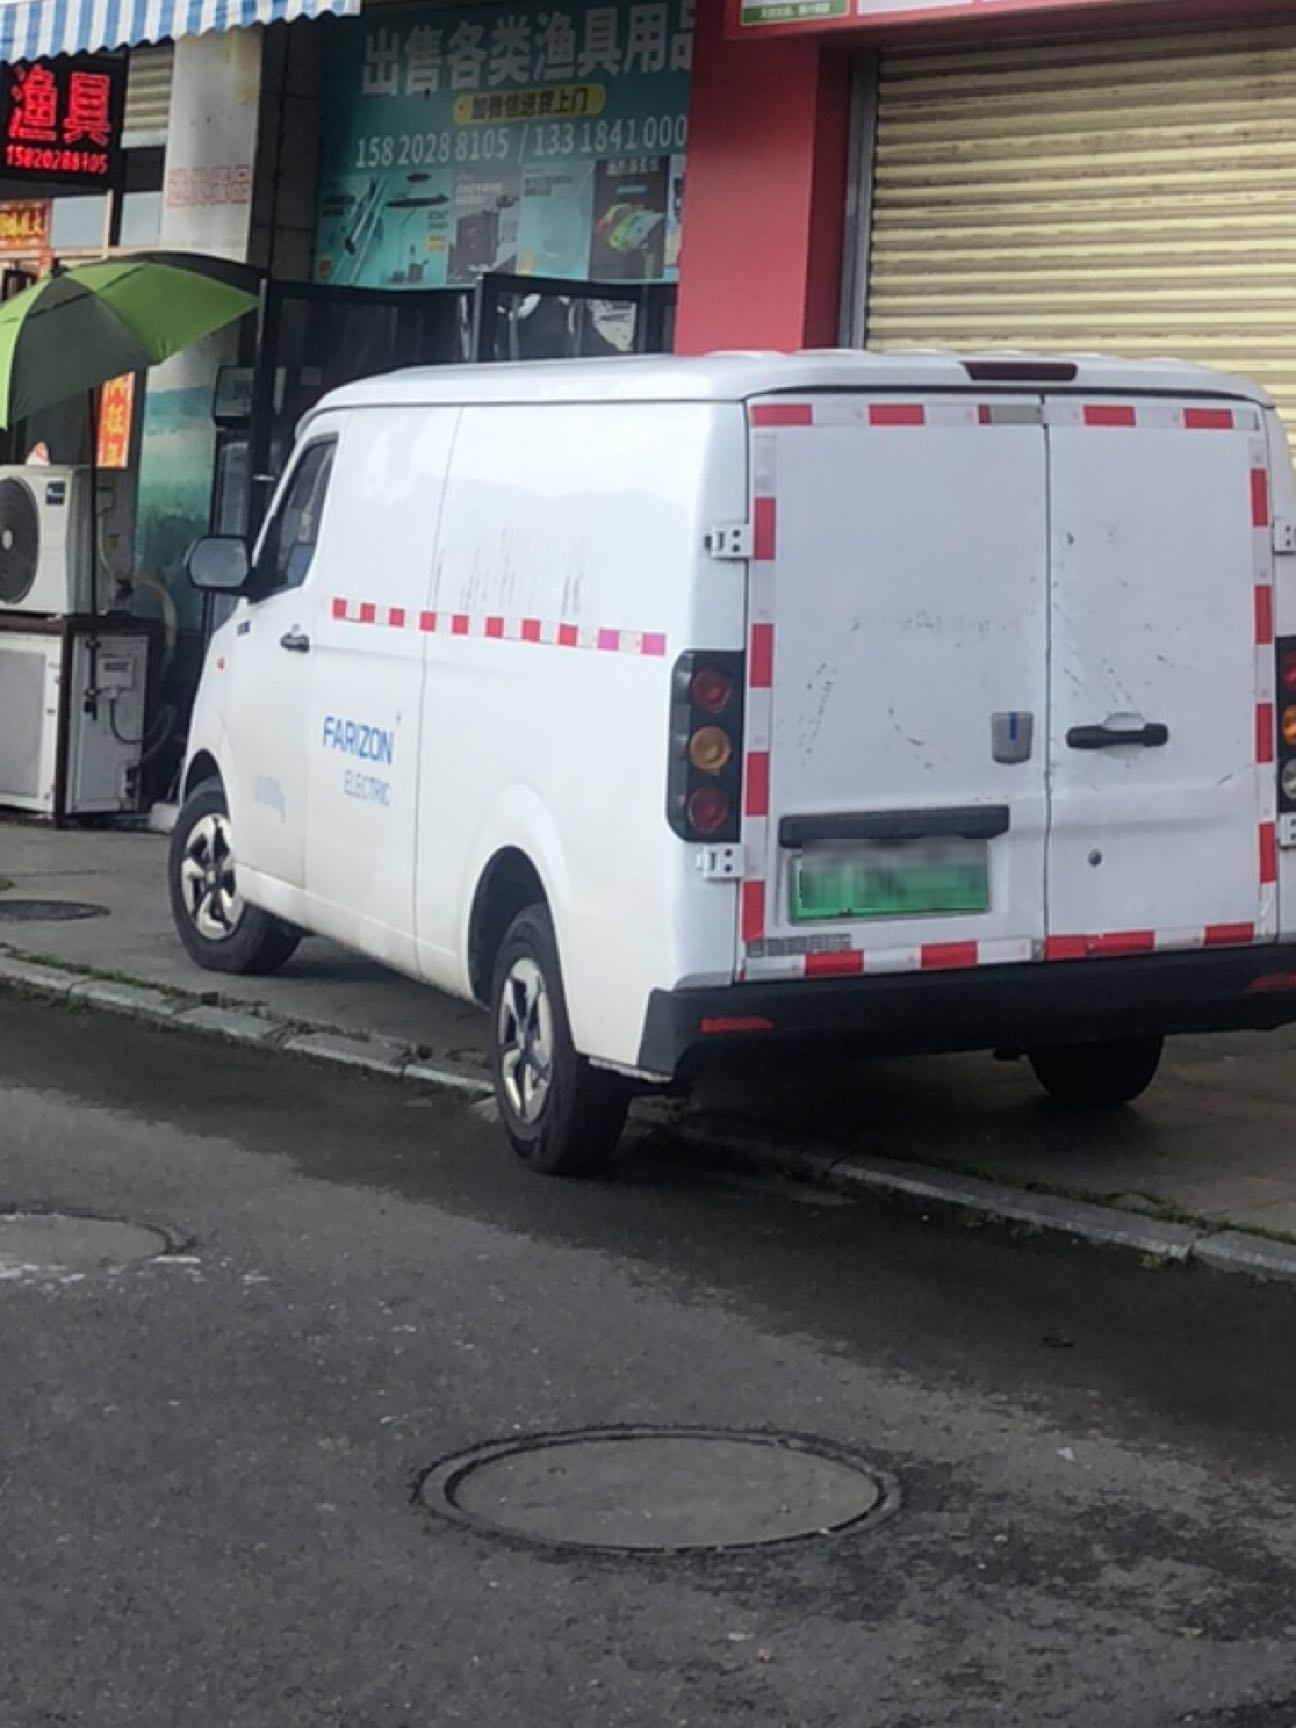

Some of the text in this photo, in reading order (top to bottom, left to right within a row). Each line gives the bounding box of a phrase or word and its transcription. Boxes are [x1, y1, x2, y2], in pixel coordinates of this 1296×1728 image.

[8, 62, 111, 147] 渔具
[322, 715, 395, 765] FARIZON
[344, 770, 391, 807] ELECTRIC
